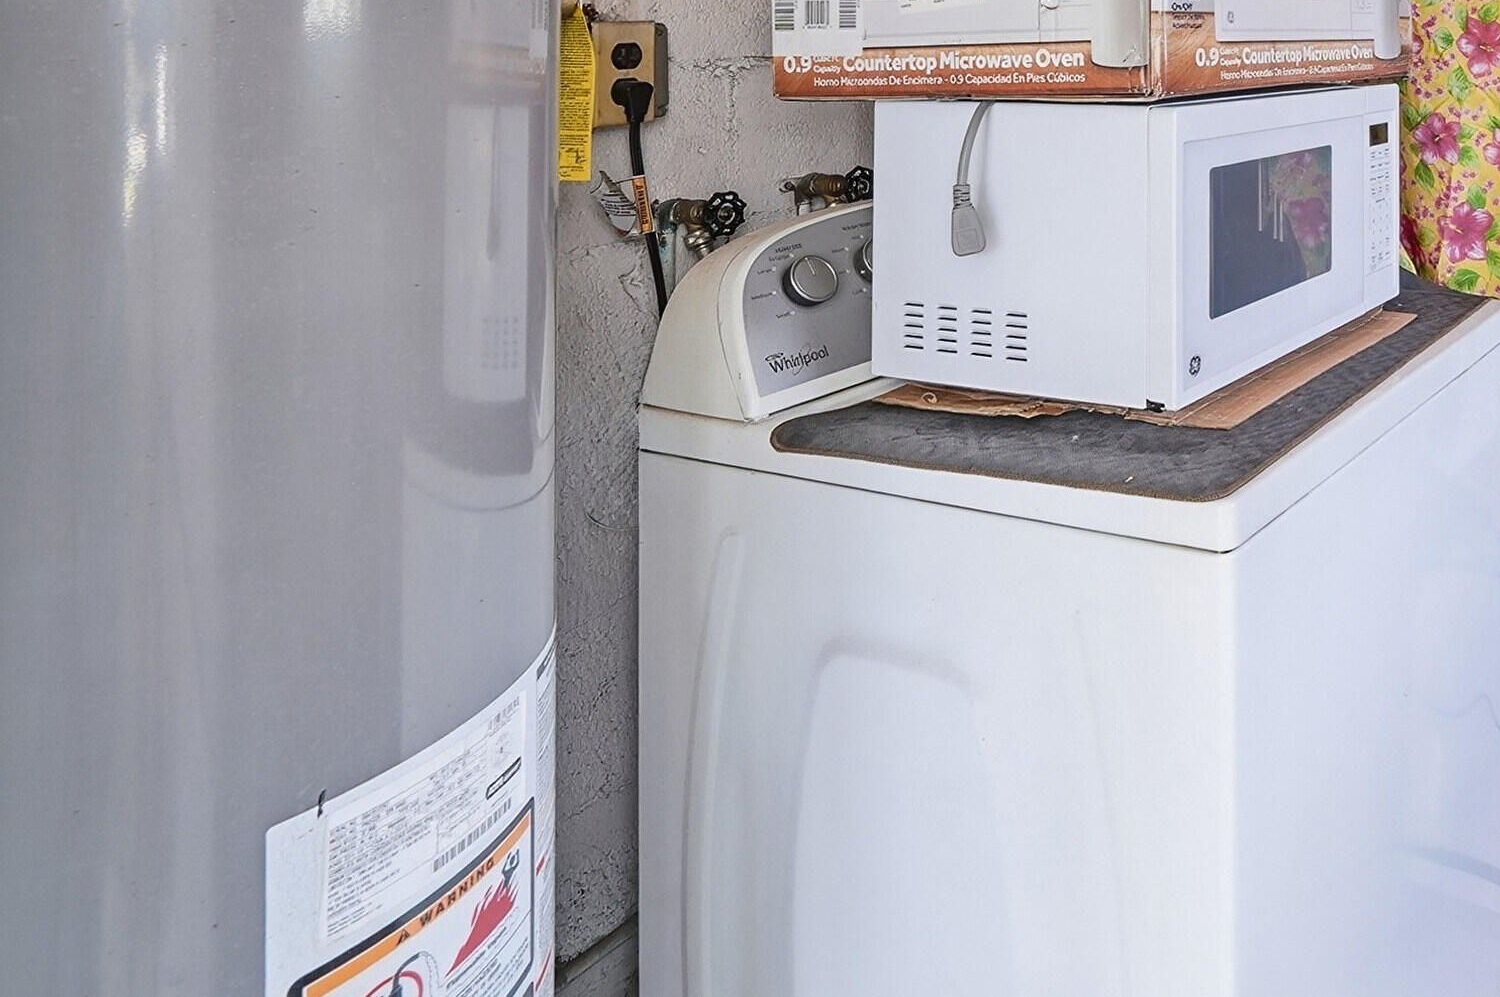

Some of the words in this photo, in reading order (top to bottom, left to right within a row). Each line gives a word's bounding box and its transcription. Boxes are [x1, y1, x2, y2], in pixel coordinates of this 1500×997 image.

[783, 55, 812, 73] 0.9
[842, 54, 937, 74] Countertop
[939, 51, 1033, 71] Microwave
[1035, 48, 1085, 67] Oven
[1195, 47, 1219, 67] 0.9
[1242, 47, 1302, 66] Countertop
[1302, 46, 1351, 62] Microwave
[1351, 44, 1373, 59] Oven
[813, 77, 840, 87] Horno
[769, 345, 829, 374] Whirlpool
[420, 856, 494, 927] WARNING
